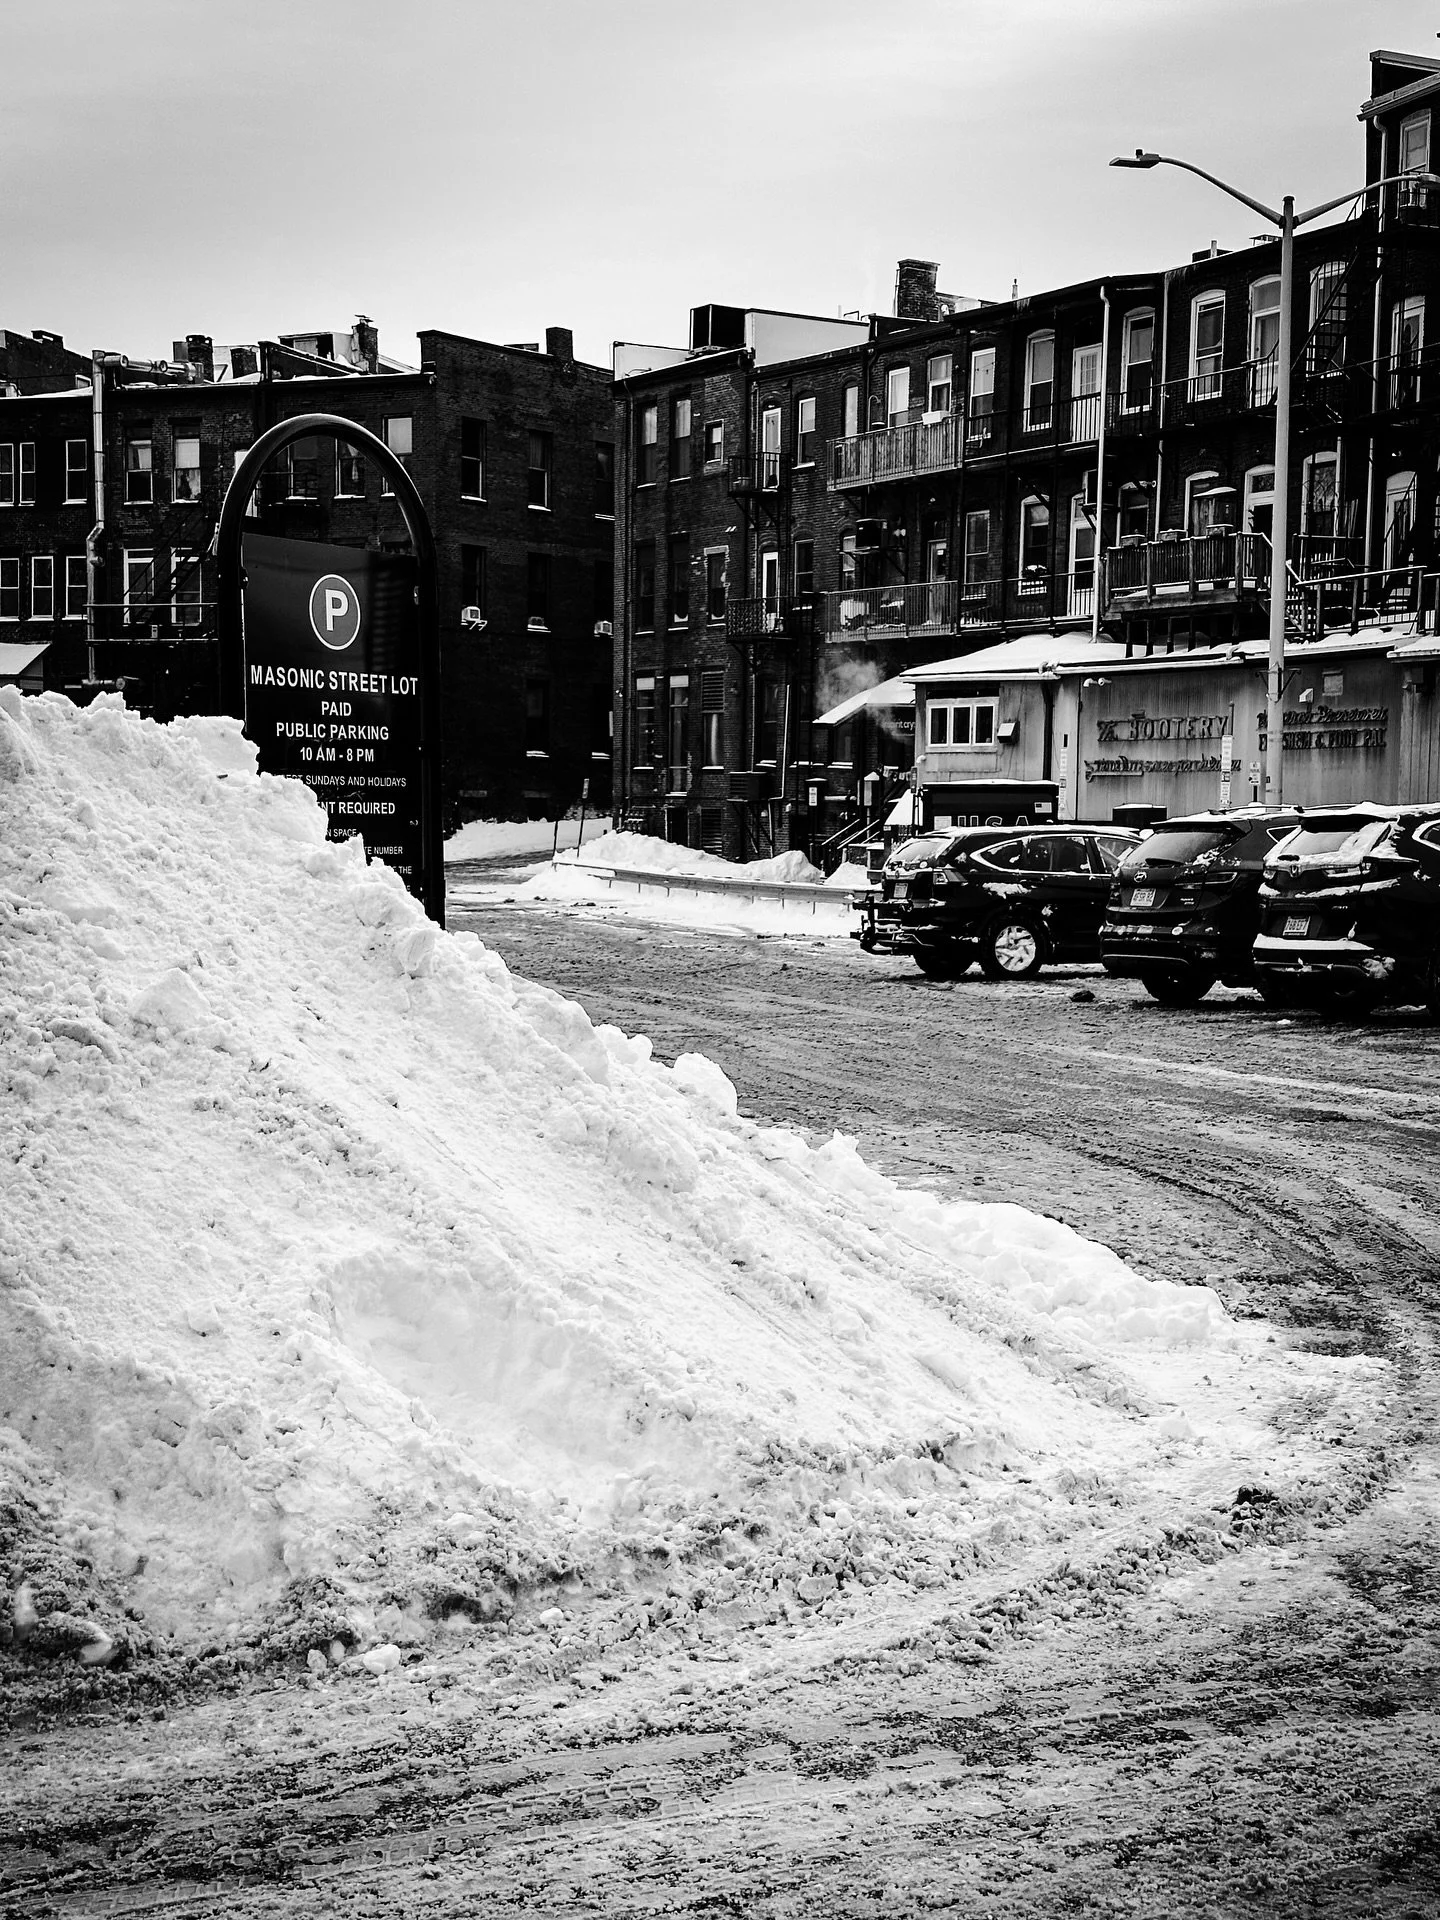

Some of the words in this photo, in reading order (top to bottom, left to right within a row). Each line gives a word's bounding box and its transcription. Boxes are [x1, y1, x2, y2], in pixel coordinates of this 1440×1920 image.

[325, 589, 349, 632] P
[251, 665, 325, 689] MASONIC
[329, 671, 387, 693] STREET
[391, 676, 418, 695] LOT
[321, 701, 352, 717] PAID
[276, 722, 326, 738] PUBLIC
[330, 724, 389, 740] PARKING
[1129, 716, 1229, 741] BOOTERY
[300, 746, 313, 761] 10
[316, 747, 336, 761] AM
[346, 748, 353, 762] 8
[356, 748, 375, 762] PM
[305, 775, 345, 786] SUNDAYS
[347, 776, 366, 786] AND
[367, 777, 407, 787] HOLIDAYS
[338, 802, 396, 814] REQUIRED
[333, 828, 357, 837] SPACE
[373, 846, 403, 855] NUMBER
[398, 866, 412, 874] THE
